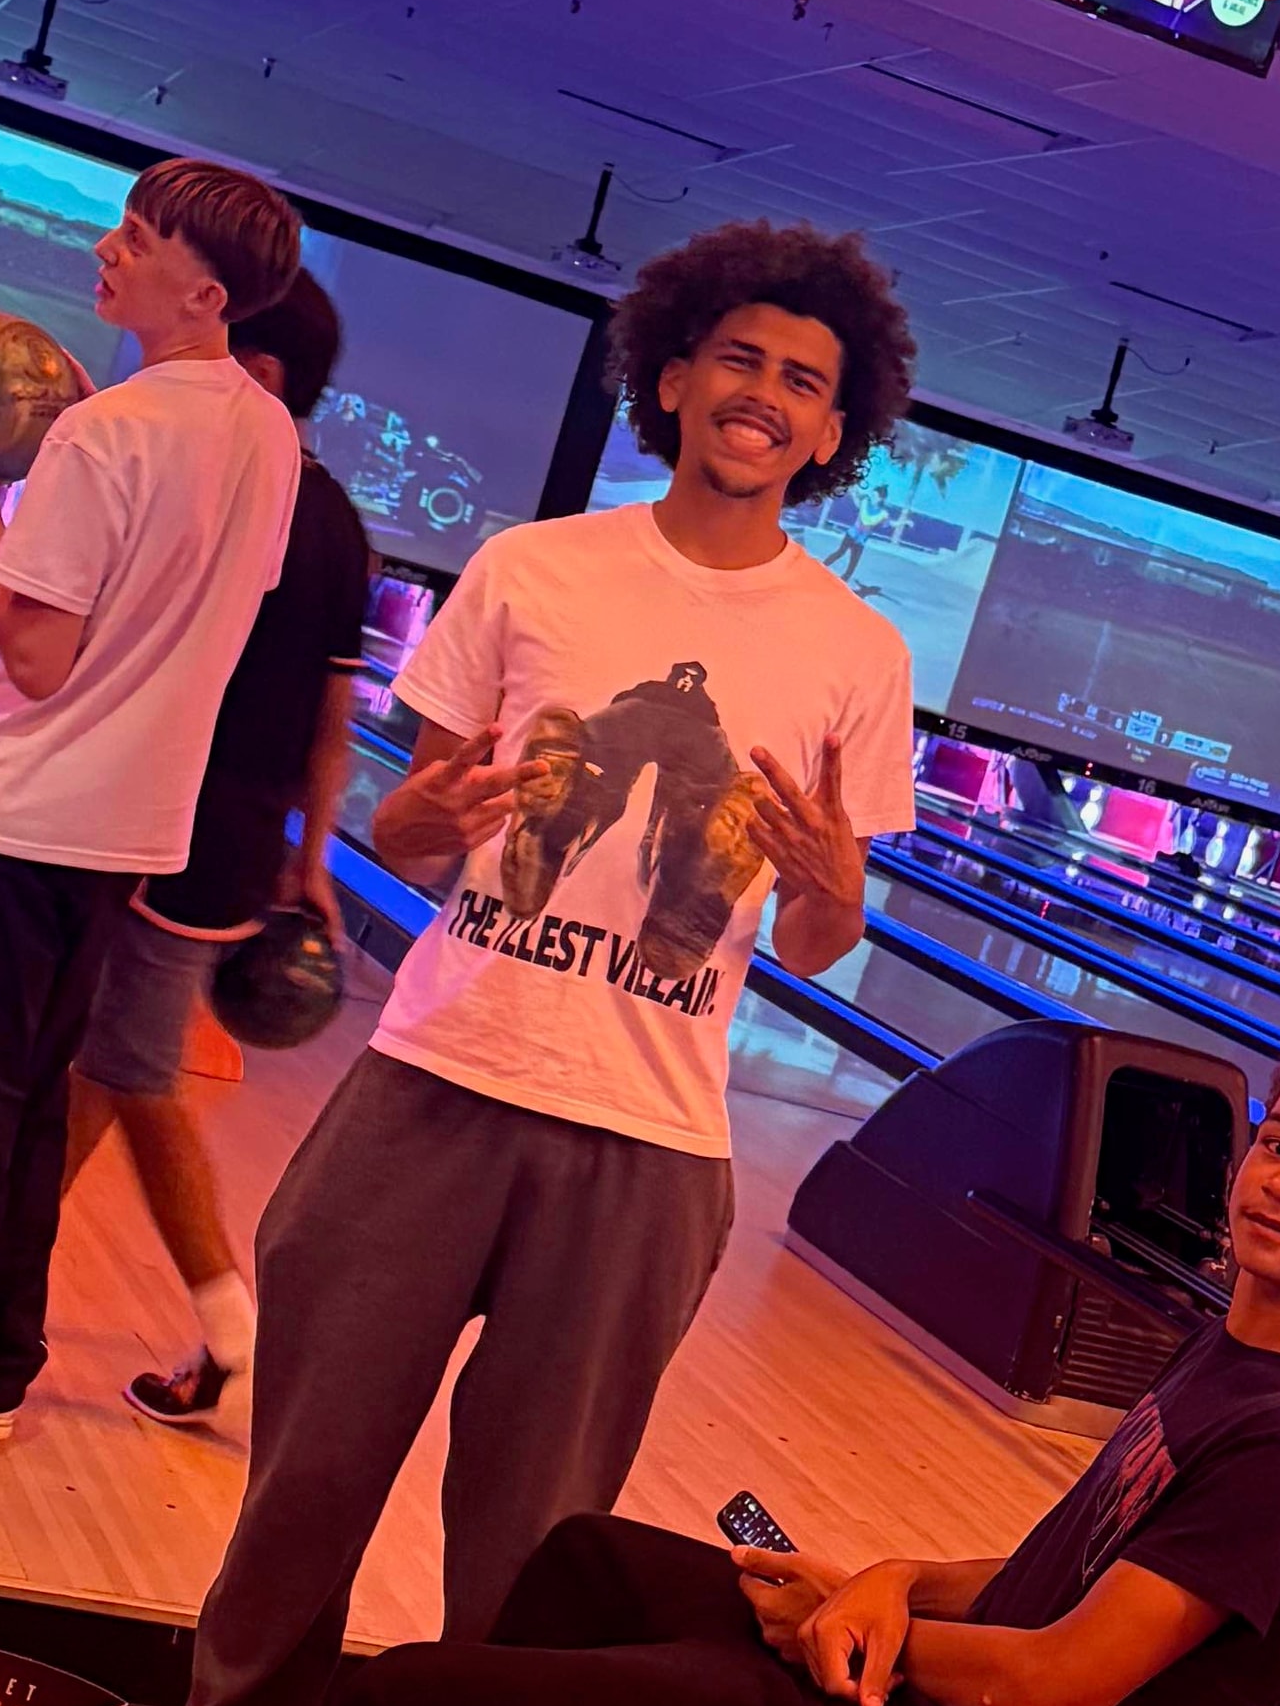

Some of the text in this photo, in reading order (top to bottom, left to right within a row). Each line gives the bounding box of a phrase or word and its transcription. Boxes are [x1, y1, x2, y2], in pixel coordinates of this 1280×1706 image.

[948, 722, 966, 740] 15
[1138, 778, 1155, 795] 16
[448, 889, 503, 949] THE
